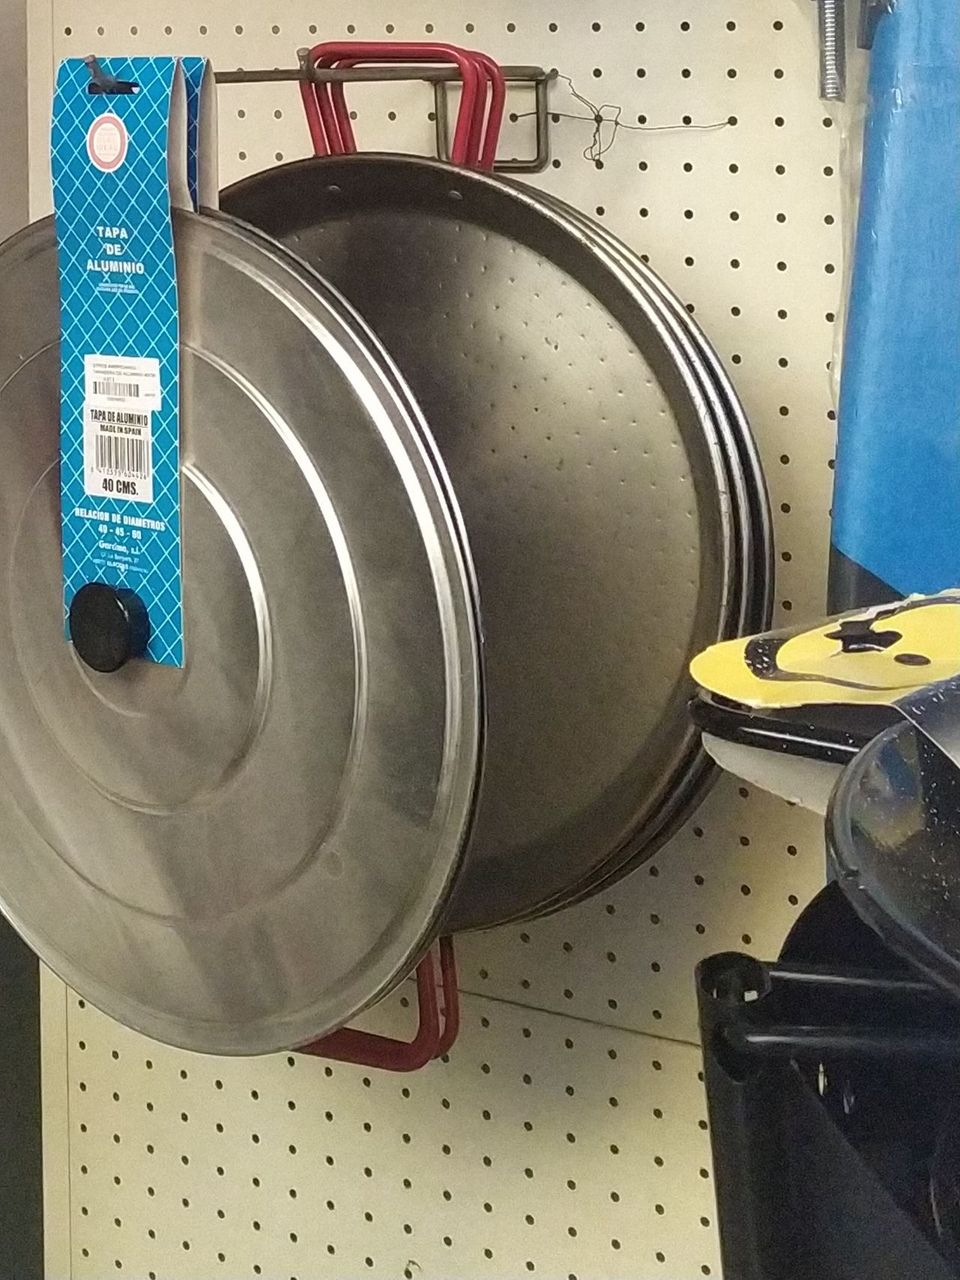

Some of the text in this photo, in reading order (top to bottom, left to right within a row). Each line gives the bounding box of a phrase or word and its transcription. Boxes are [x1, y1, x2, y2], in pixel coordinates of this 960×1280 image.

[96, 226, 129, 239] TAPA
[105, 243, 122, 256] DE
[86, 259, 145, 274] ALUMINIO
[90, 409, 148, 426] TAPA DE ALUMINIO
[102, 478, 139, 496] 40 CMS.
[74, 507, 166, 531] RELACION DE DIAMETROS
